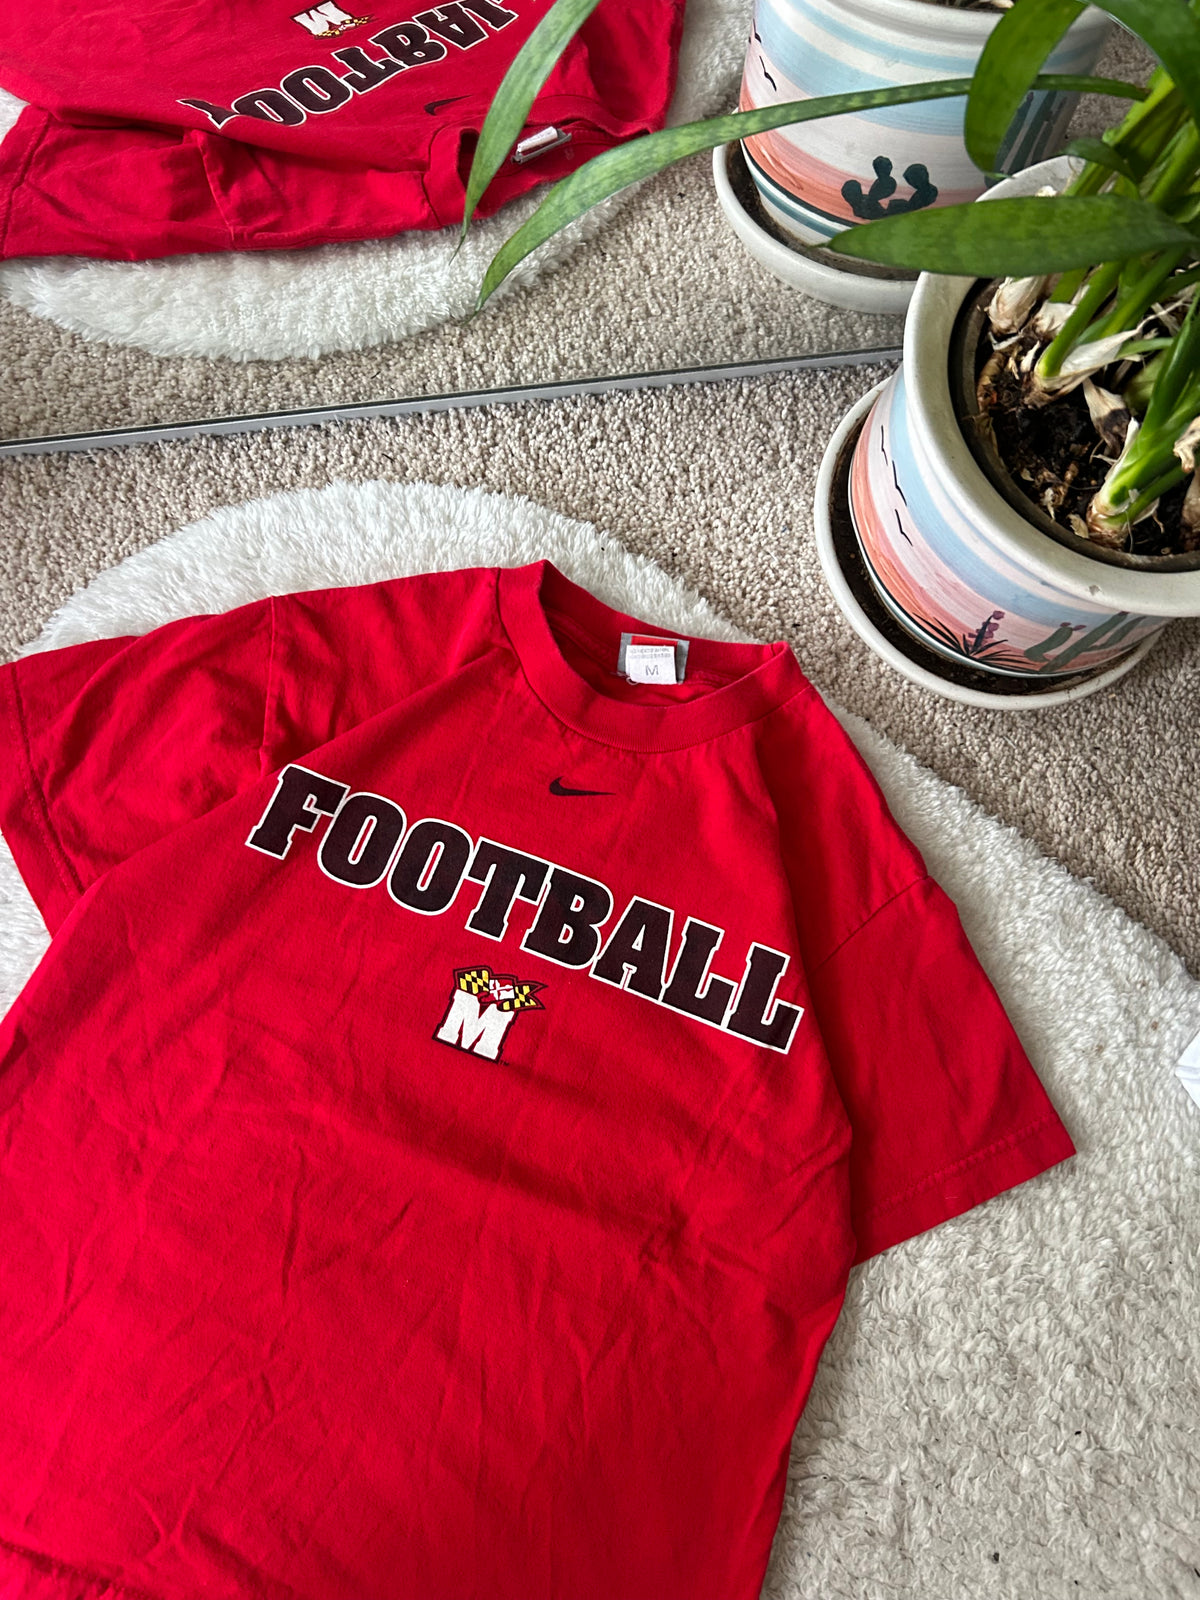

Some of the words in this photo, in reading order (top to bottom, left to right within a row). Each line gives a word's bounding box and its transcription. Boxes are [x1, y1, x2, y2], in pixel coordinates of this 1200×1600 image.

[645, 664, 660, 676] M
[244, 763, 805, 1055] FOOTBALL
[433, 987, 518, 1063] M
